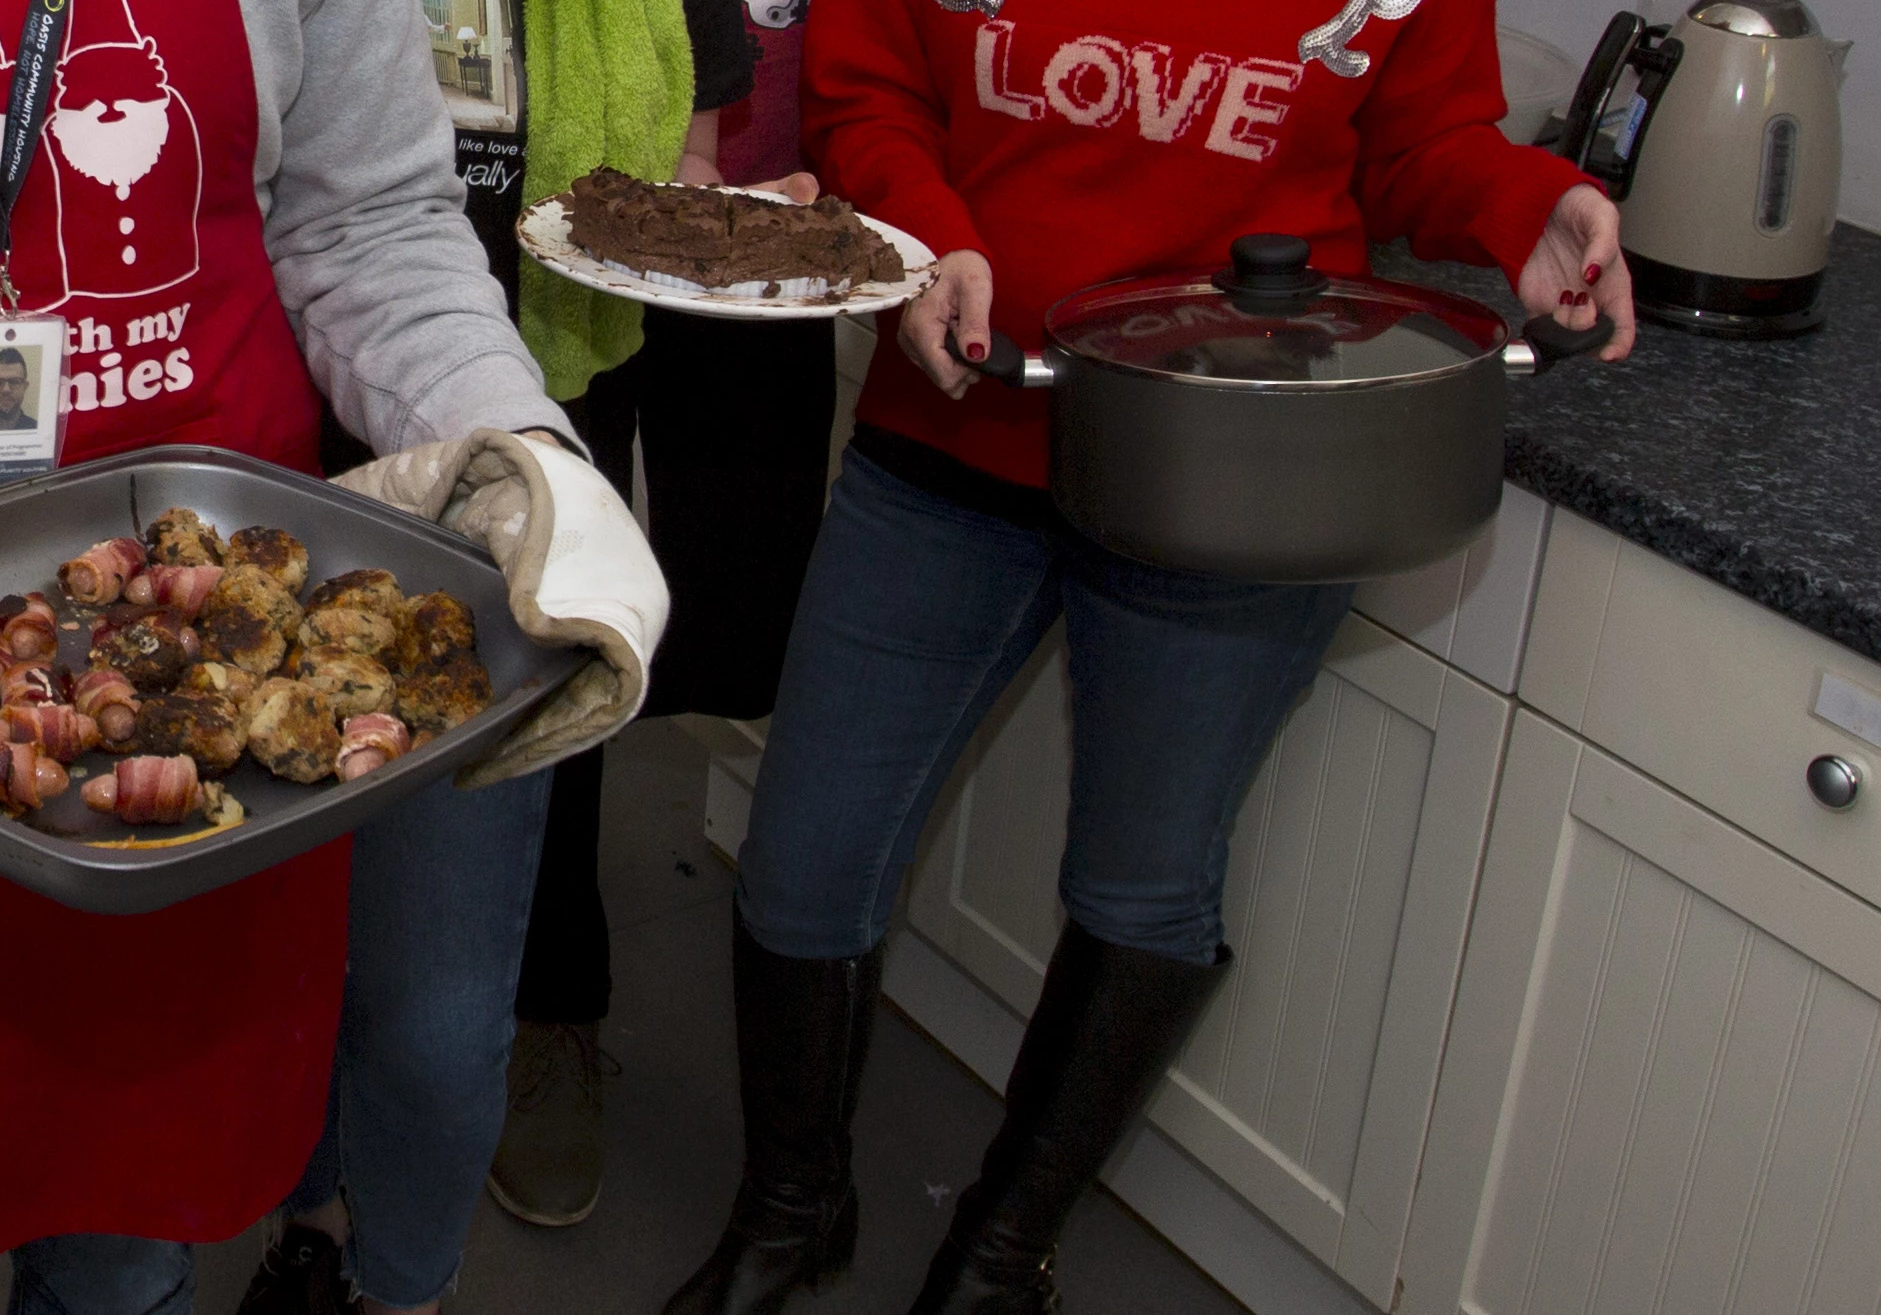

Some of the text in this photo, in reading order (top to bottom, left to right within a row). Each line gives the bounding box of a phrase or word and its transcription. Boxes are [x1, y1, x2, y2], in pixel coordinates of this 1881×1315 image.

[8, 13, 54, 183] OASIS COMMUNITY HOUSING
[975, 20, 1304, 162] LOVE
[458, 138, 484, 152] like
[487, 140, 518, 156] love
[126, 302, 191, 347] my
